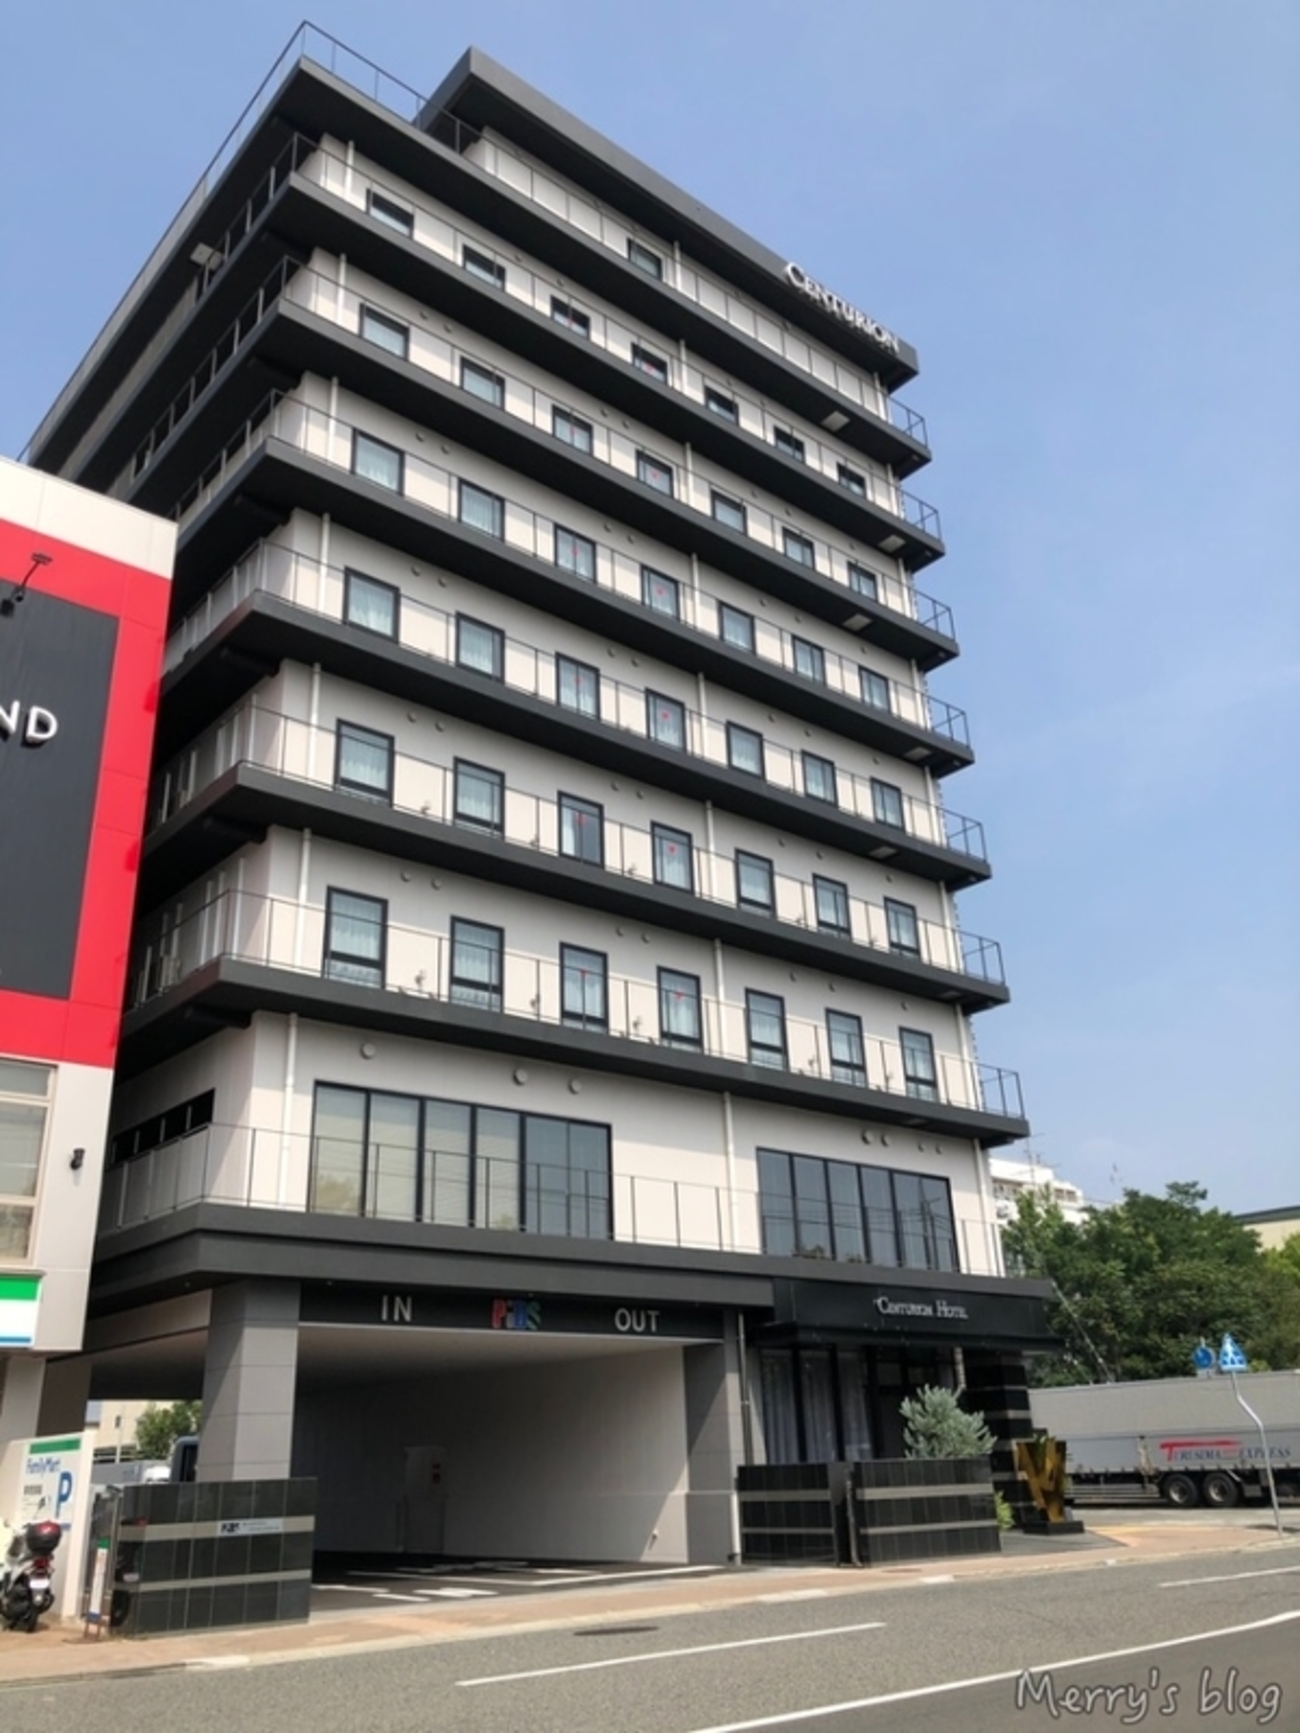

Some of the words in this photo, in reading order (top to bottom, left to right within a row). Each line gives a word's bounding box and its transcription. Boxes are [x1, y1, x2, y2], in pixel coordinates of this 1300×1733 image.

[381, 1296, 412, 1322] IN
[614, 1308, 660, 1332] OUT
[56, 1471, 73, 1519] P
